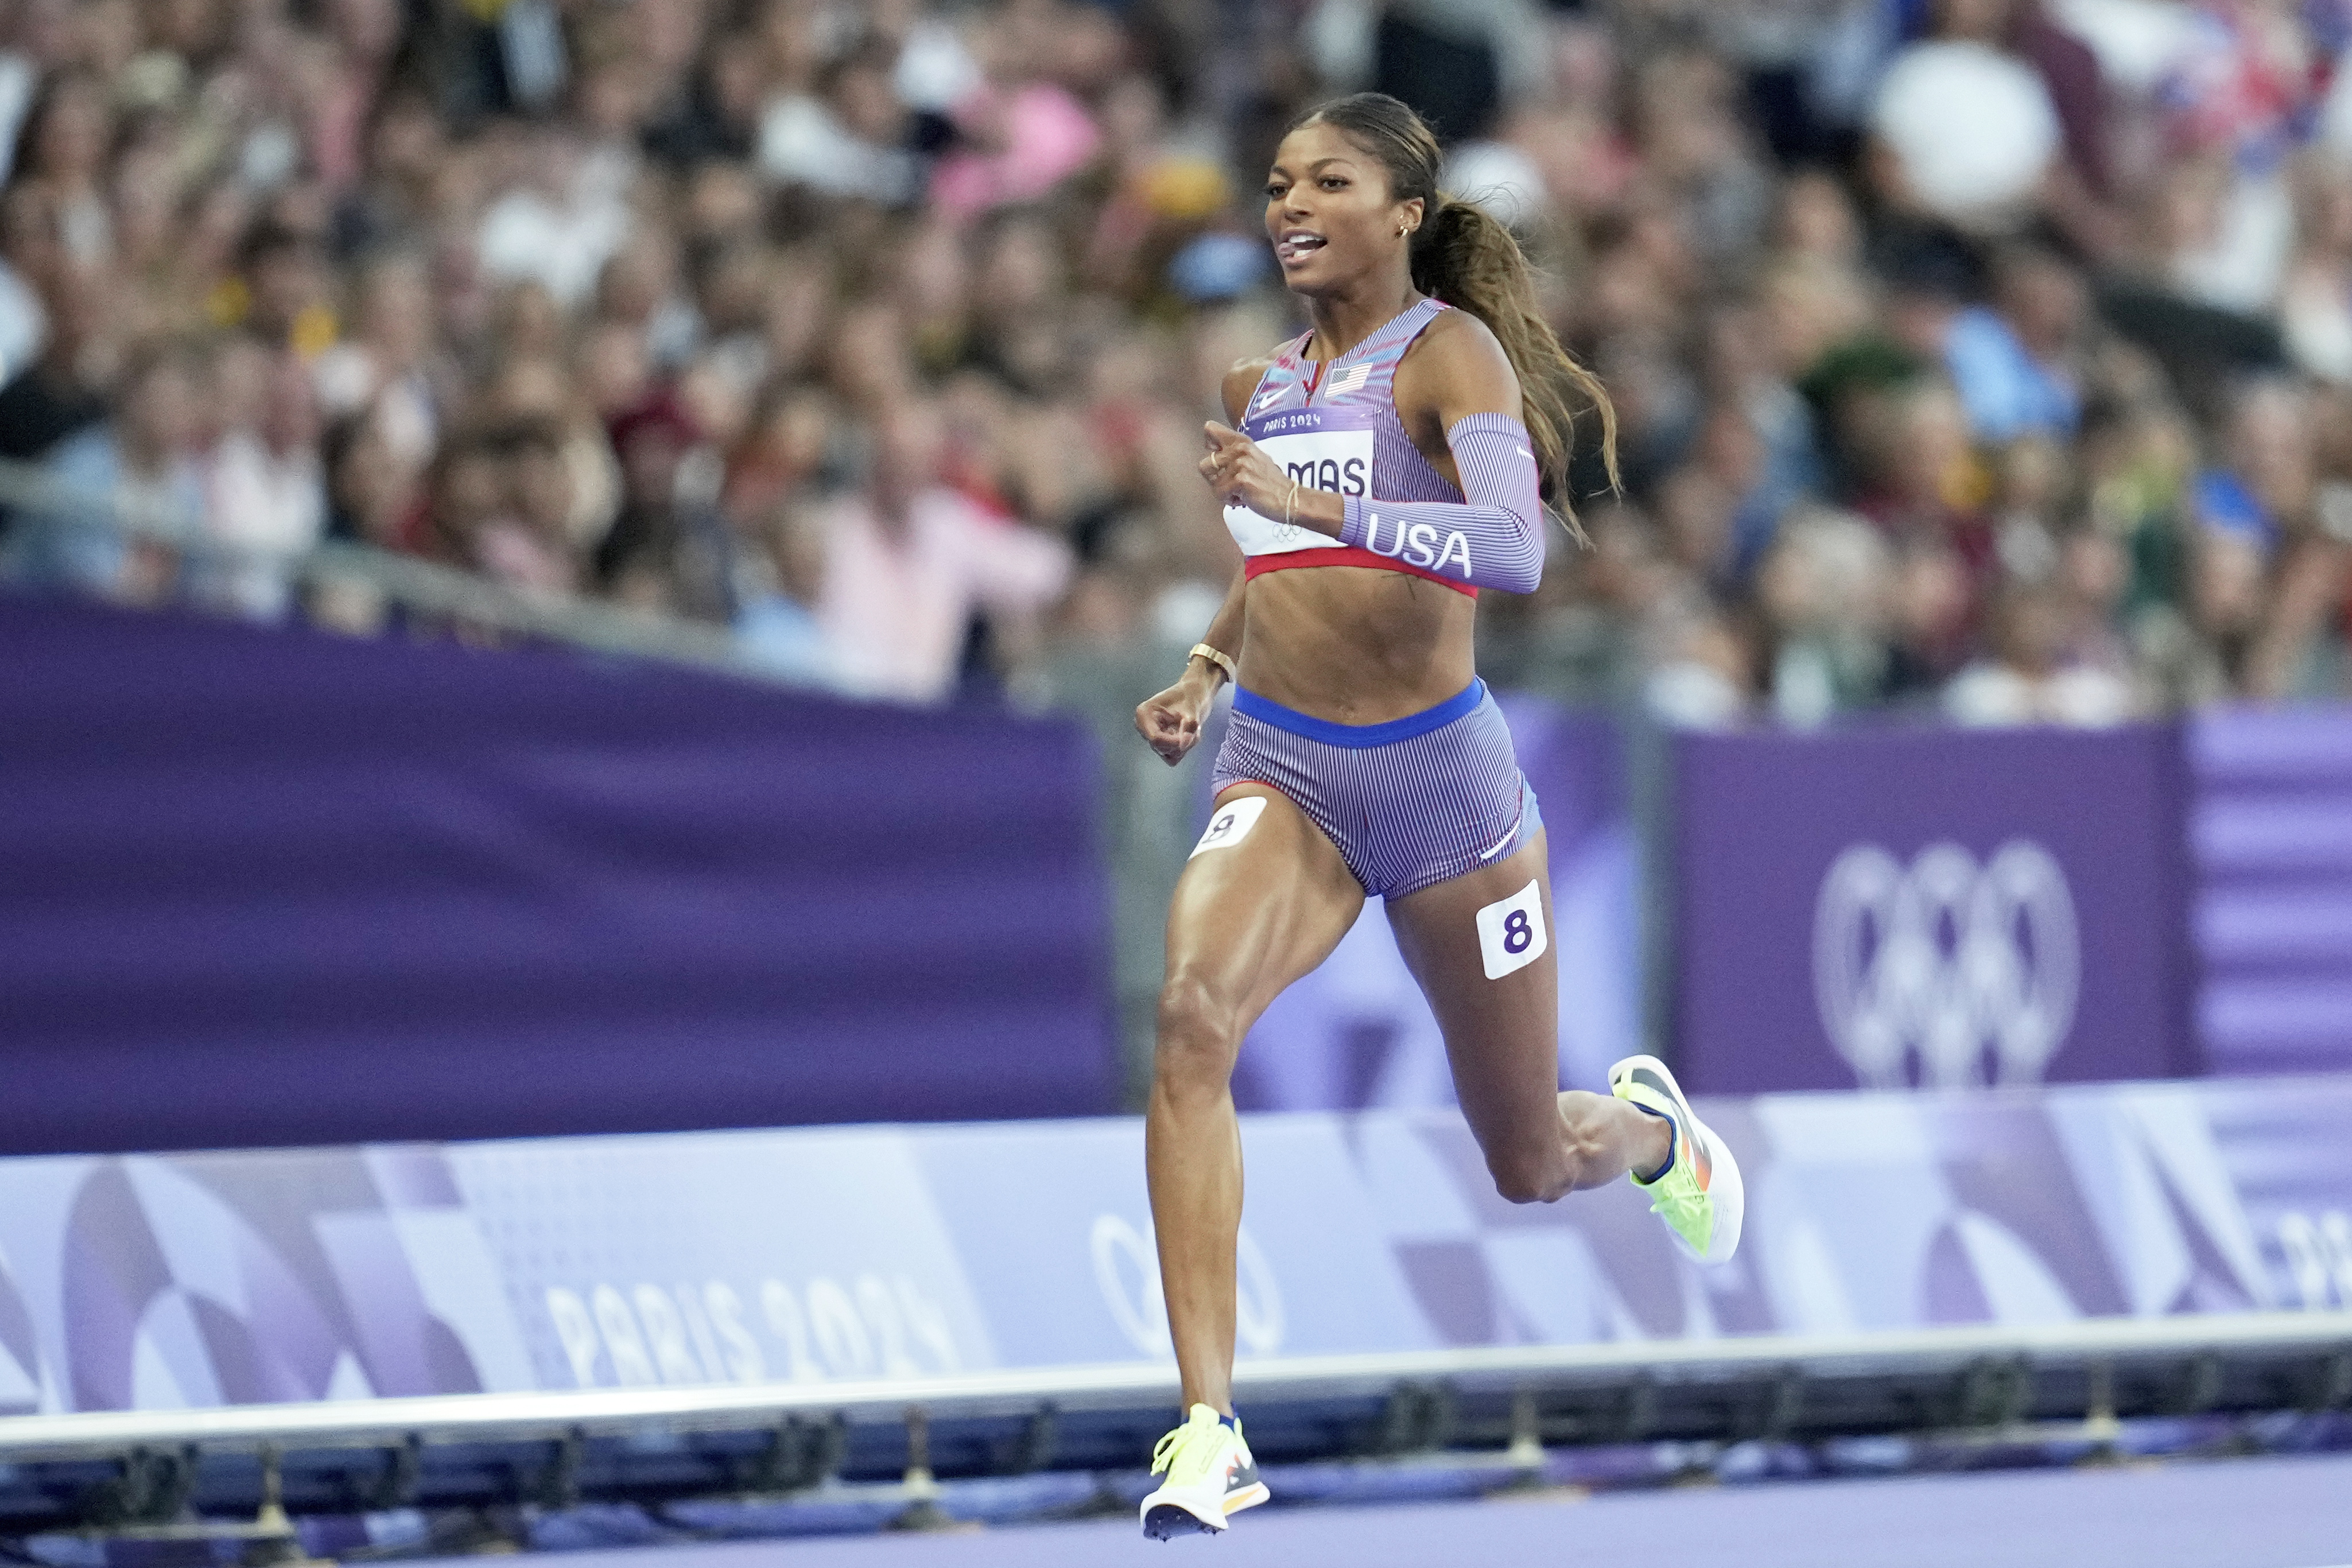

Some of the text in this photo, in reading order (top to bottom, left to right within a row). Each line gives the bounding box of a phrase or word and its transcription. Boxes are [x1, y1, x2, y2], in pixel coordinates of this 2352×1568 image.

[1263, 413, 1321, 433] PARIS 2024
[1275, 457, 1365, 497] MAS
[1366, 513, 1472, 579] USA
[1503, 909, 1532, 954] 8
[545, 1274, 962, 1387] PARIS 2024
